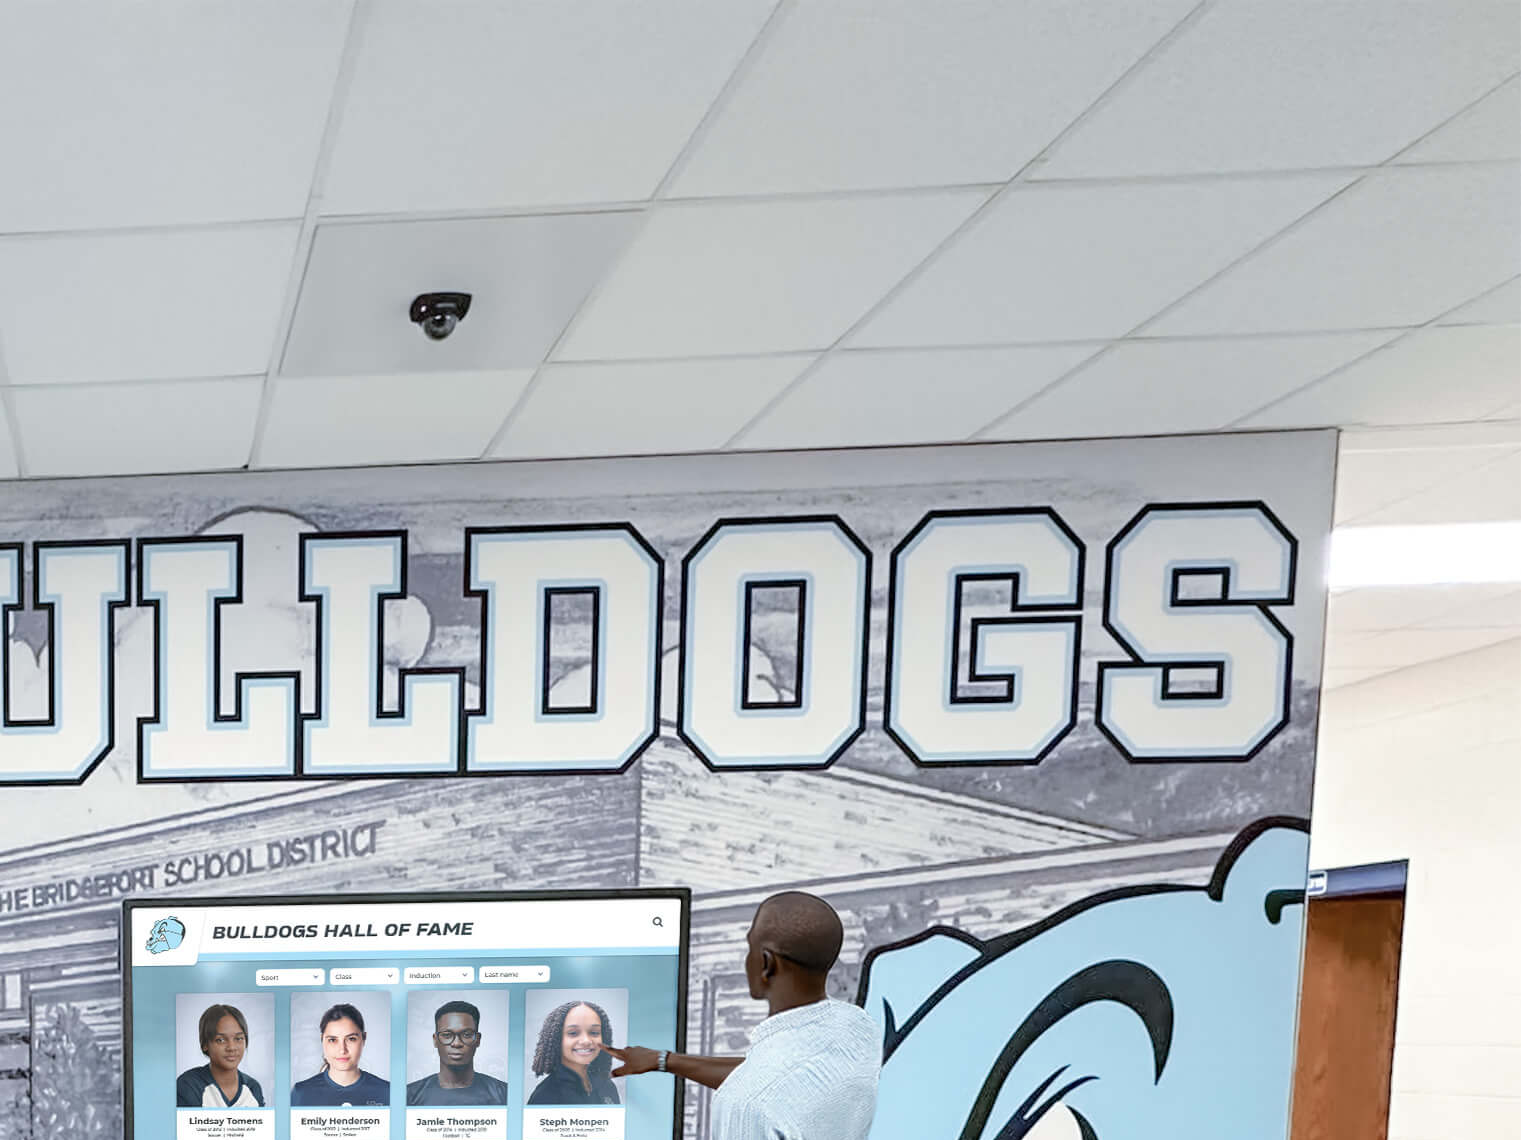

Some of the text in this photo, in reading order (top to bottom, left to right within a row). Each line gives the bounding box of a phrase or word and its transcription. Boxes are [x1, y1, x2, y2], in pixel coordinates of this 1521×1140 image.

[163, 847, 266, 888] SCHOOL
[267, 819, 388, 868] DISTRICT
[212, 921, 475, 940] BULLDOGS HALL OF FAME
[260, 973, 280, 983] Sport
[334, 972, 353, 981] Class
[408, 970, 442, 980] Induction
[484, 970, 520, 979] Last name
[188, 1116, 264, 1127] Lindsay Tomens
[300, 1116, 381, 1128] Emily Henderson
[415, 1117, 498, 1128] Jamie Thompson
[538, 1117, 610, 1128] Steph Monpen
